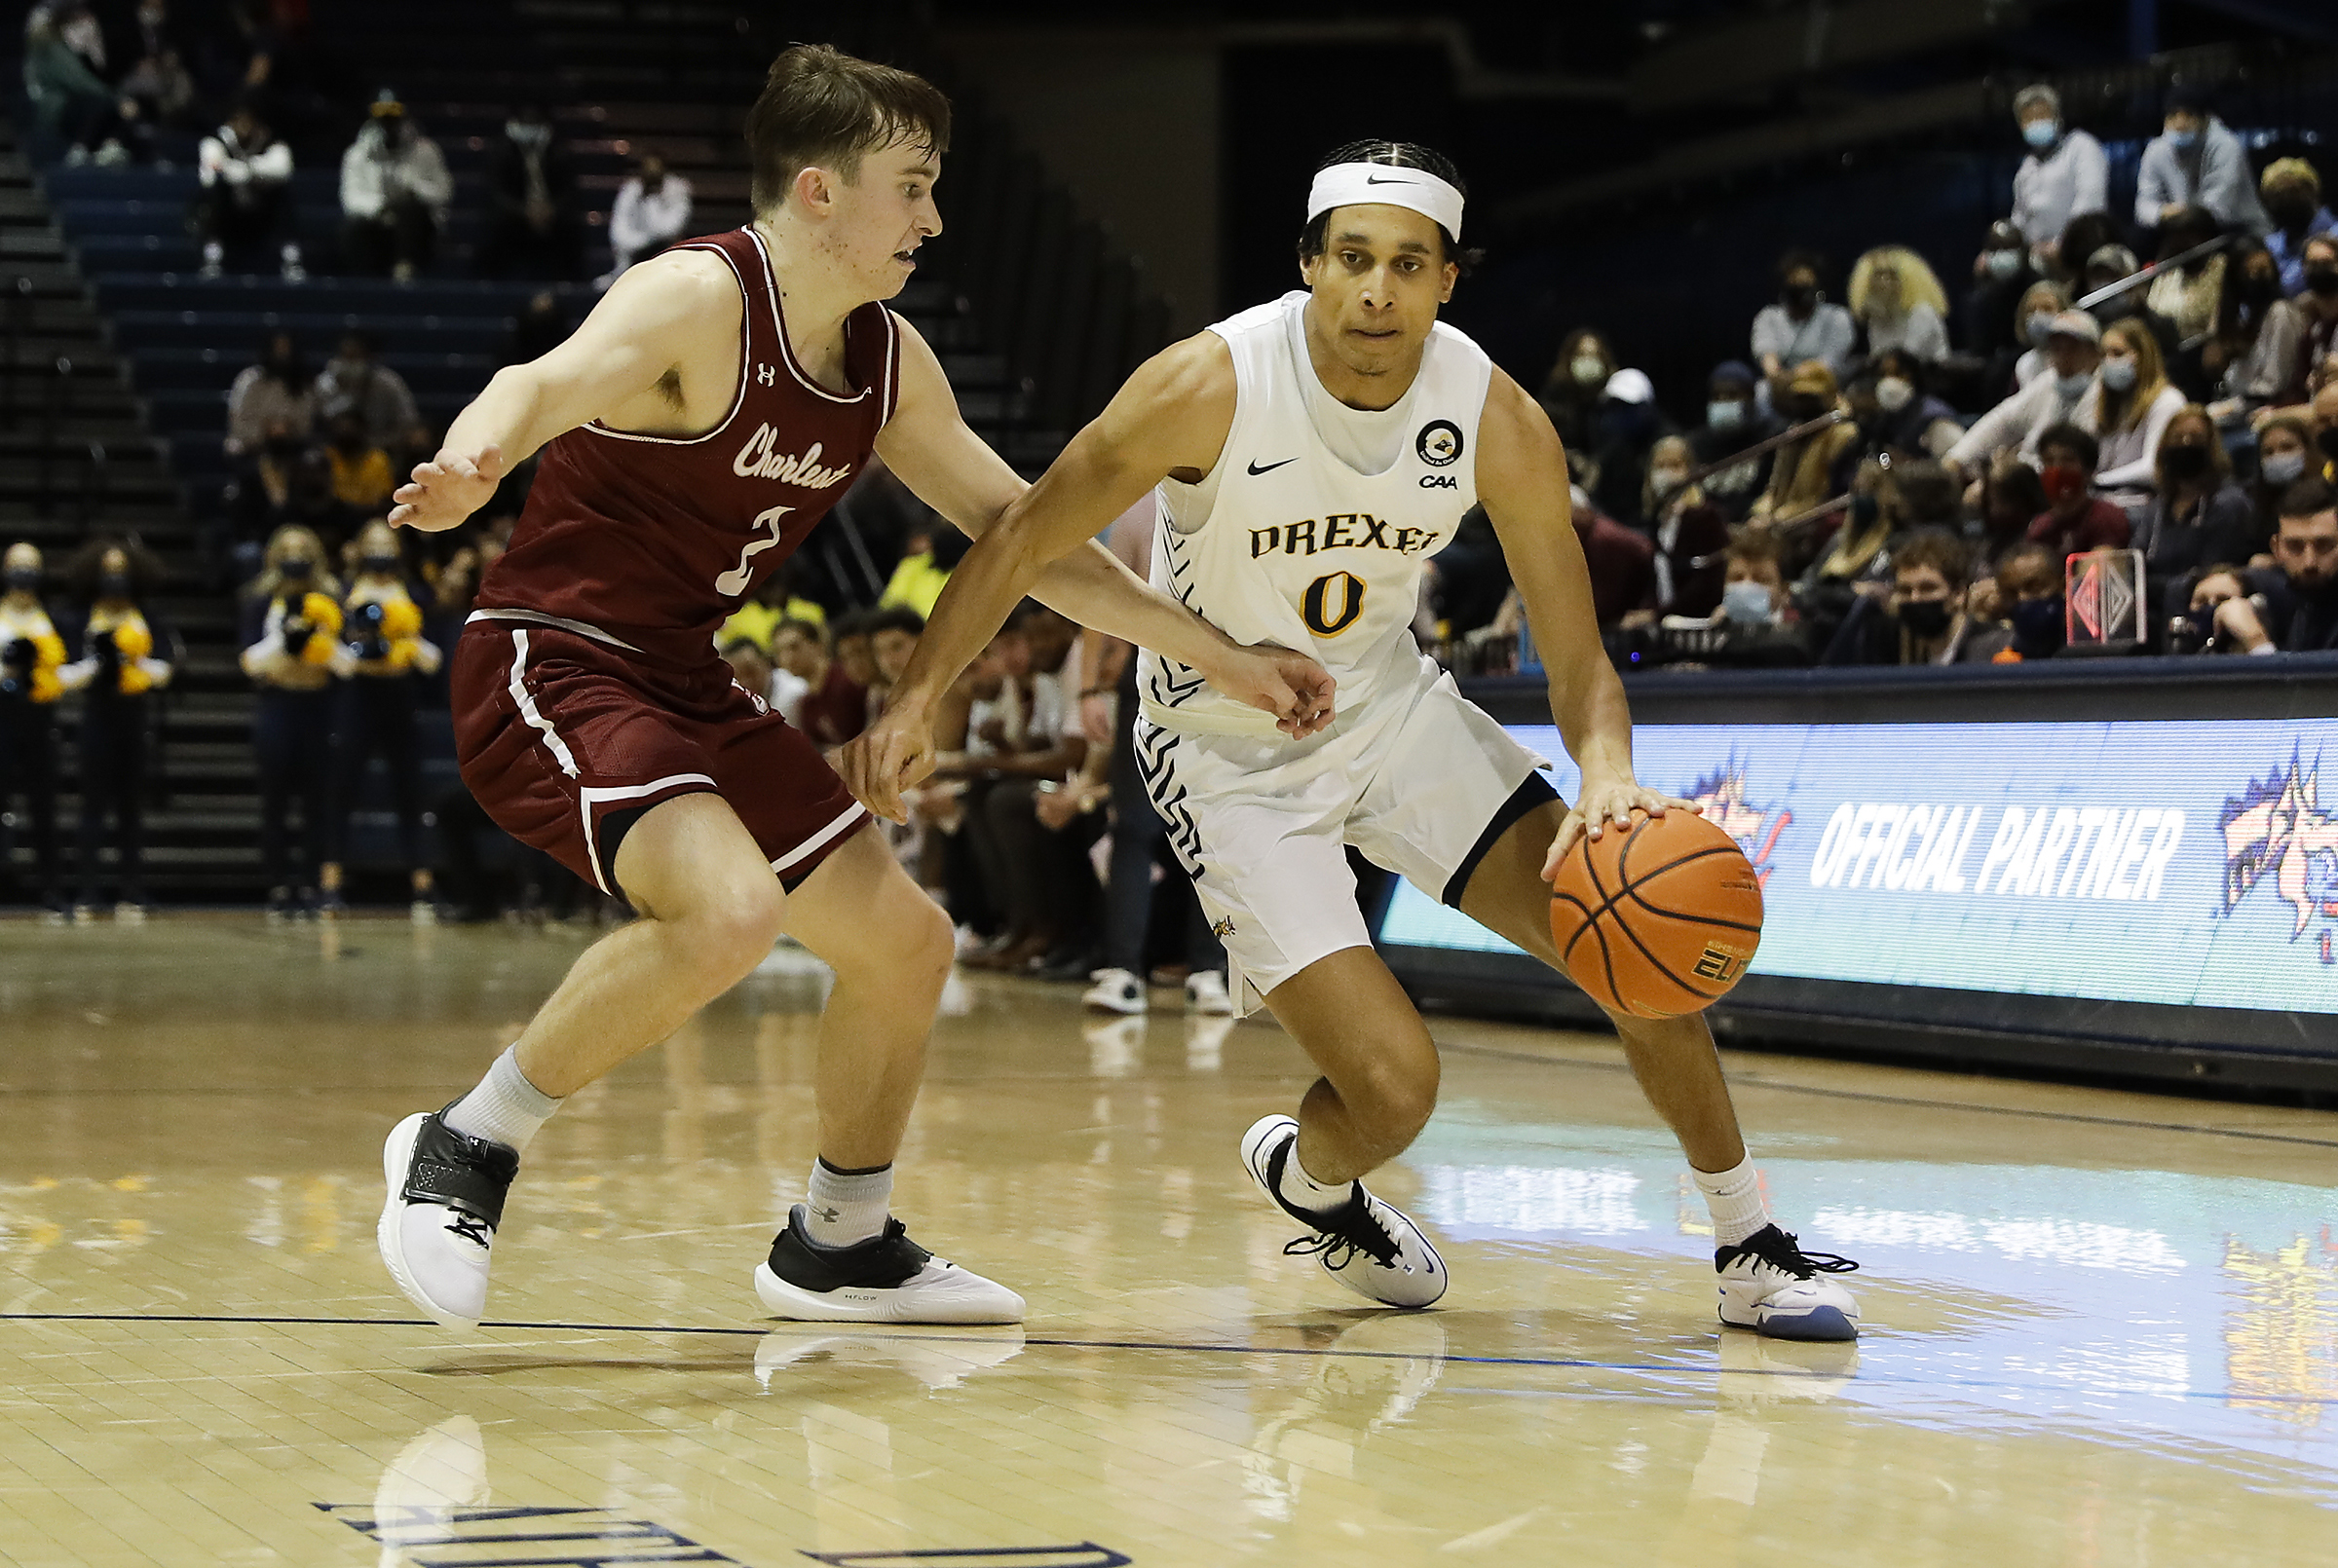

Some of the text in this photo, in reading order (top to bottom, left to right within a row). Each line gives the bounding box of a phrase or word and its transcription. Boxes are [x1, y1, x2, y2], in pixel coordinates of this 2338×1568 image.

[1418, 474, 1458, 491] CAA
[1299, 570, 1368, 639] 0
[1810, 802, 2186, 902] OFFICIAL PARTNER
